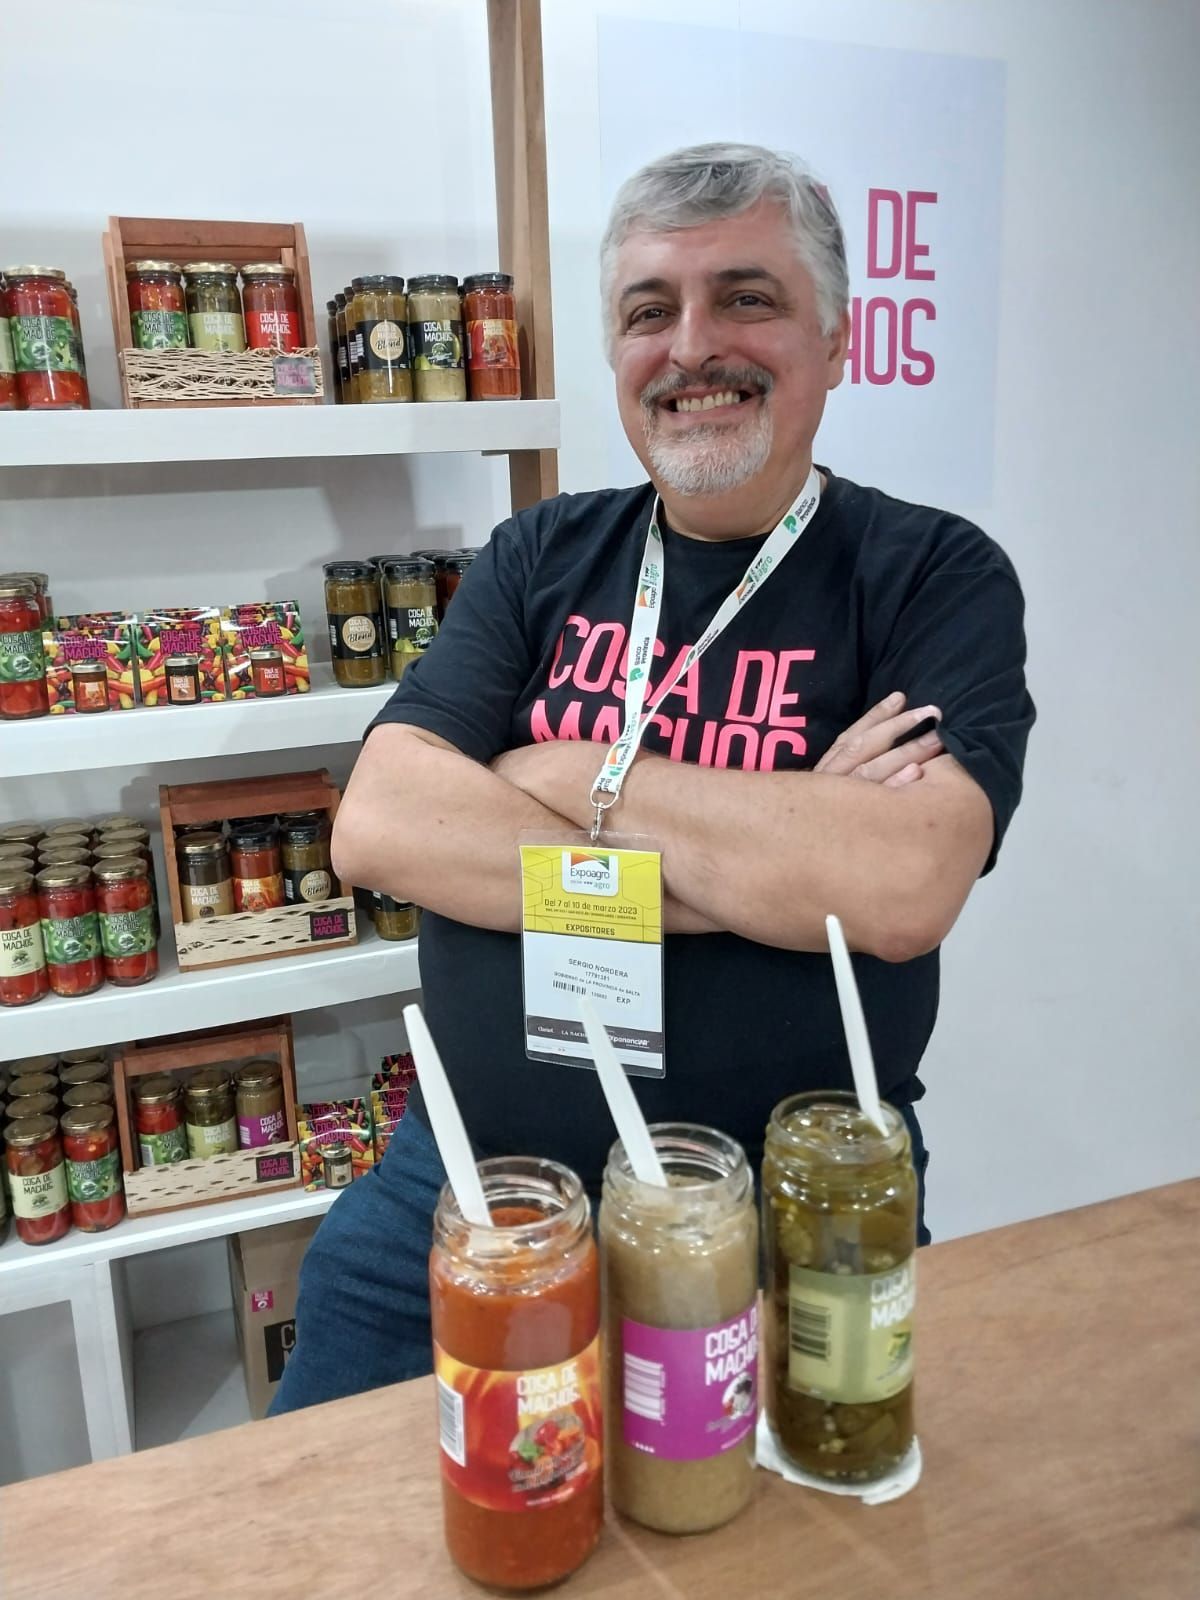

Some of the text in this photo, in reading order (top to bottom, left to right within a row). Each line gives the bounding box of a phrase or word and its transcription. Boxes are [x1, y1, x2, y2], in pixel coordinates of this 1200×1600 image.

[867, 188, 938, 281] DE
[260, 313, 290, 323] COSA DE
[260, 323, 292, 334] MACHOS
[64, 635, 105, 648] COSA DE
[160, 630, 201, 642] COSA DE
[65, 647, 107, 660] MACHOS
[160, 641, 202, 653] MACHOS
[725, 649, 816, 728] DE
[570, 867, 610, 881] Expoagro
[544, 898, 555, 907] Del
[558, 899, 562, 907] 7
[563, 900, 571, 908] al
[572, 901, 580, 909] 10
[582, 902, 591, 911] de
[593, 905, 617, 913] marzo
[619, 906, 638, 915] 2023
[1, 928, 32, 942] COSA DE
[566, 923, 615, 936] EXPOSITORES
[3, 938, 34, 951] MACHOS
[568, 958, 629, 978] SERGIO NORDERA
[616, 996, 631, 1005] EXP
[22, 1173, 51, 1187] COSA DE
[23, 1182, 53, 1195] MACHOS
[705, 1318, 749, 1359] COSA
[516, 1362, 578, 1395] COSA DE
[518, 1386, 582, 1416] MACHOS
